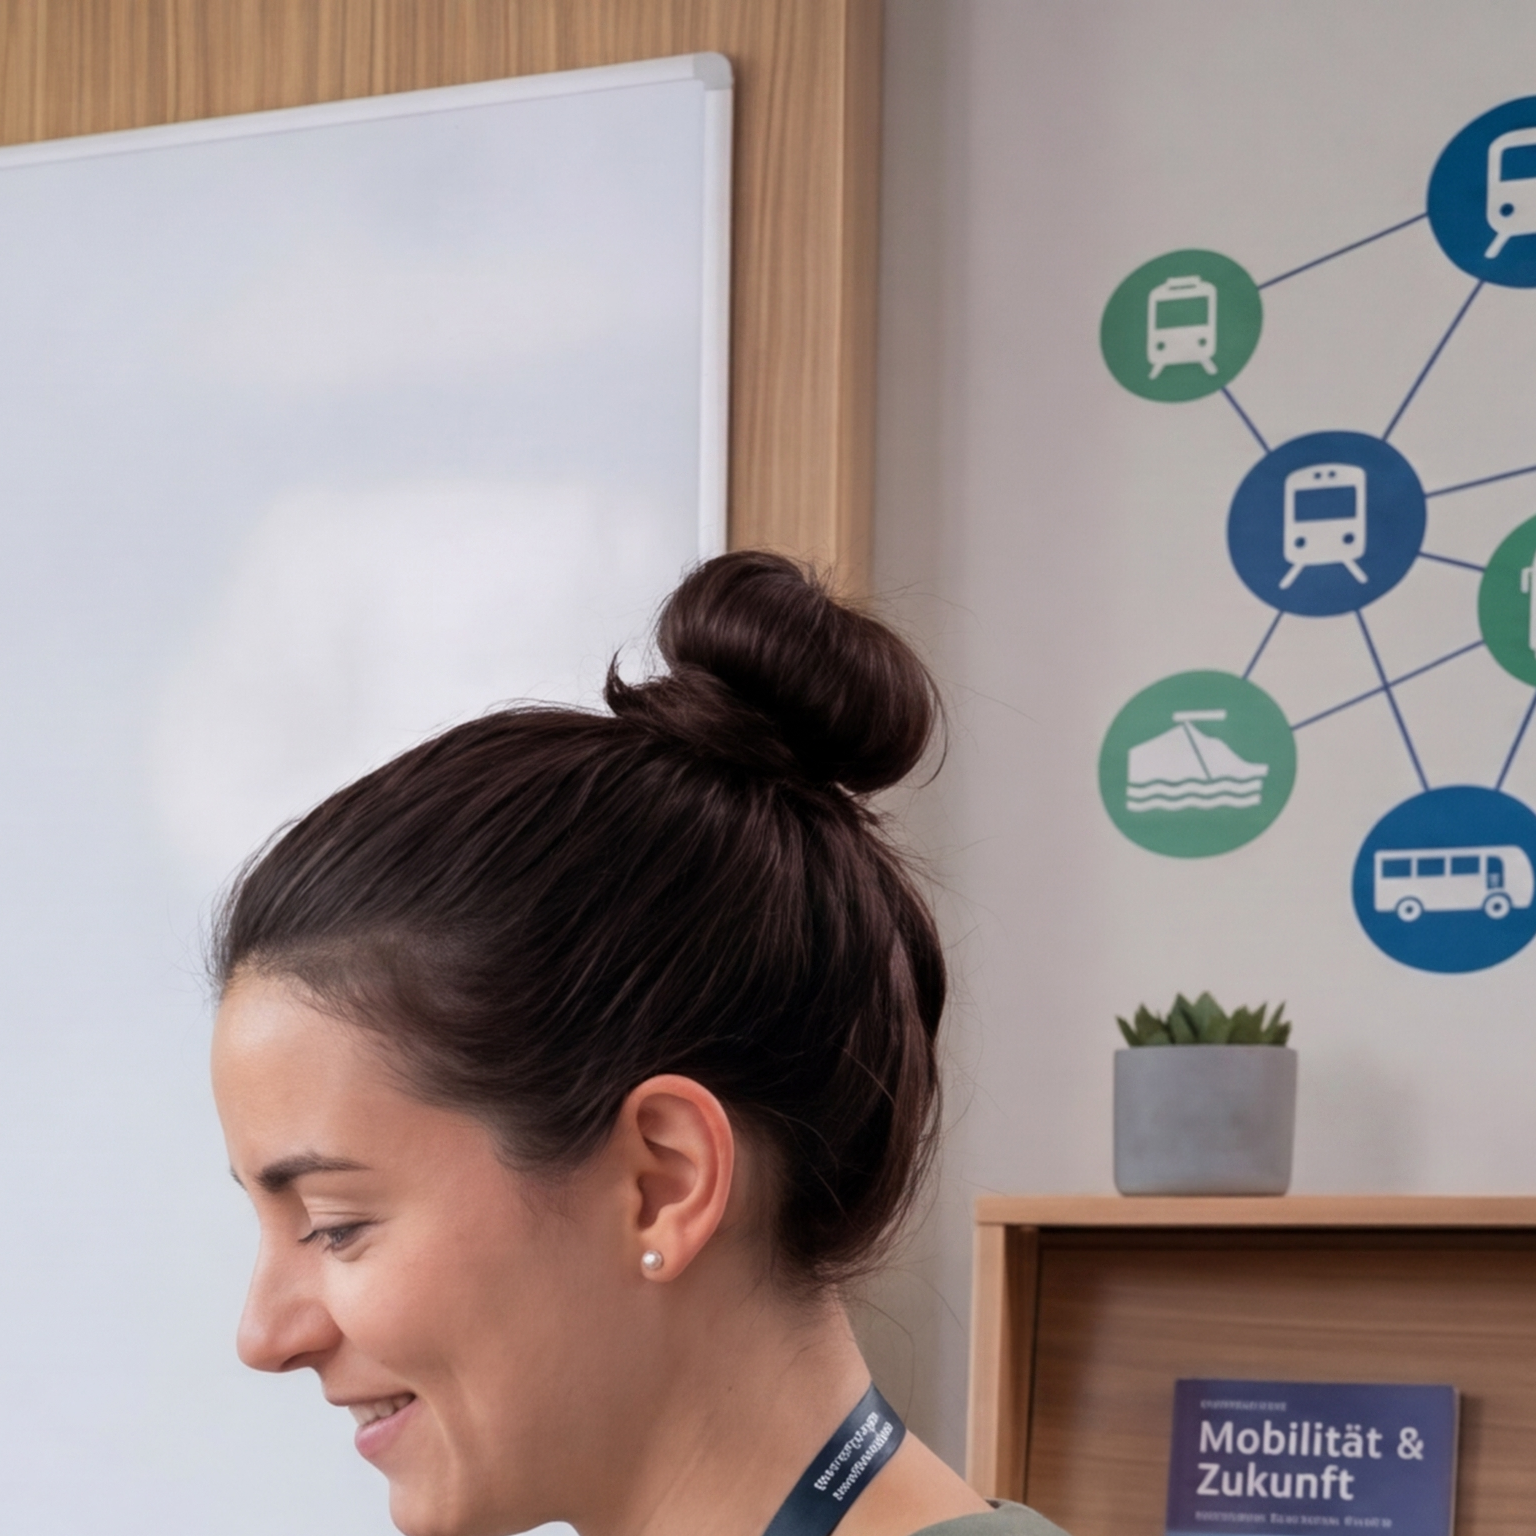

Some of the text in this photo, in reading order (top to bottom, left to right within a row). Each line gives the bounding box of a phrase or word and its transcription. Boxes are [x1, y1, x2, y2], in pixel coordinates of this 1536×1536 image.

[1199, 1420, 1425, 1461] Mobilität &
[1195, 1461, 1355, 1501] Zukunft
